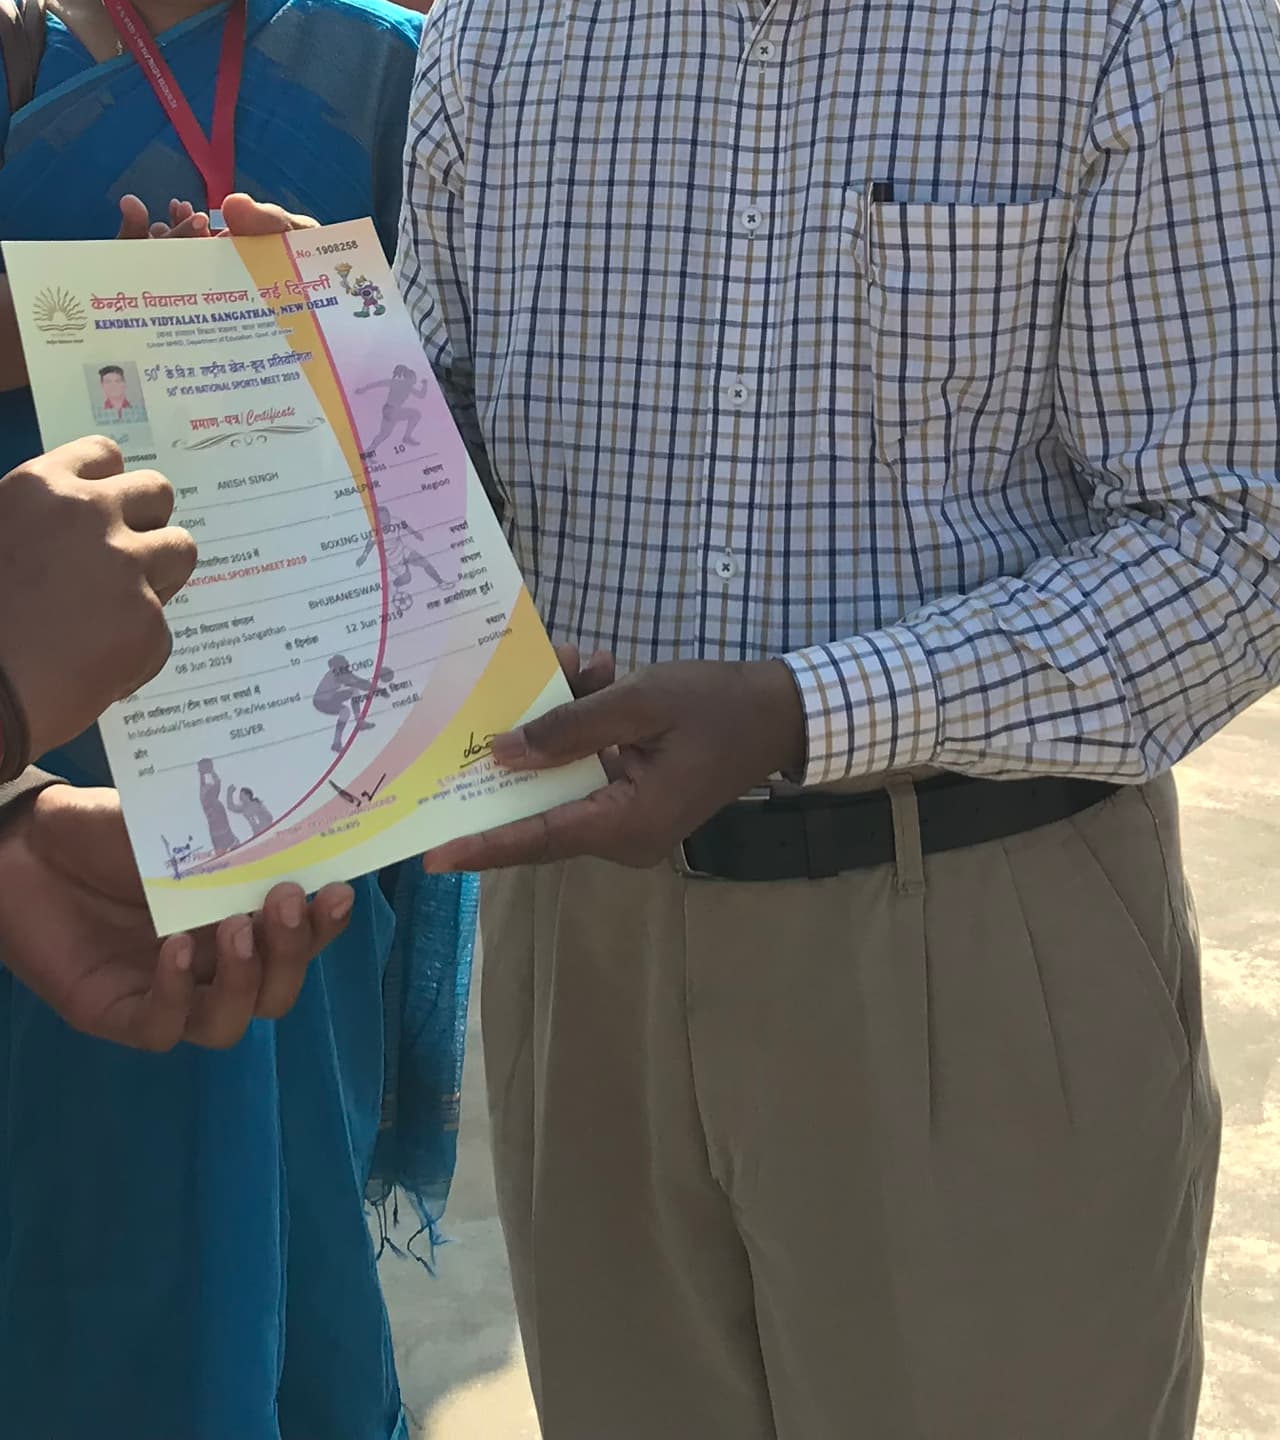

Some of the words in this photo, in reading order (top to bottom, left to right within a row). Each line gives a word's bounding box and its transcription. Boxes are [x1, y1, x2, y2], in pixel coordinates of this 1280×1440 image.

[90, 291, 139, 312] केन्द्रीय
[142, 291, 199, 308] विद्यालय
[258, 281, 282, 300] नई
[285, 274, 332, 296] दिल्ली
[94, 318, 148, 330] KENDRIYA
[150, 313, 209, 327] VIDYALAYA
[280, 302, 304, 314] NEW
[306, 296, 339, 310] DELHI
[195, 383, 231, 395] NATIONAL
[231, 379, 260, 392] SPORTS
[260, 374, 280, 387] MEET
[281, 371, 300, 384] 2019
[393, 444, 406, 456] 10
[217, 477, 248, 491] ANISH
[248, 471, 280, 487] SINGH
[421, 477, 451, 492] Region
[333, 480, 382, 500] JABALPUR
[178, 517, 206, 529] SIDHI
[320, 533, 359, 551] BOXING
[450, 536, 475, 550] event
[230, 550, 252, 564] 2019
[227, 565, 261, 581] SPORTS
[261, 560, 285, 574] MEET
[285, 555, 309, 568] 2019
[457, 566, 488, 581] Region
[308, 582, 383, 610] BHUBANESWAR
[345, 622, 358, 634] 12
[358, 617, 377, 631] Jun
[200, 633, 241, 652] Vidyalaya
[241, 624, 287, 643] Sangathan
[477, 627, 513, 646] position
[208, 654, 233, 667] 2019
[290, 657, 301, 667] to
[267, 692, 301, 709] secured
[229, 722, 265, 741] SILVER
[138, 764, 155, 777] and
